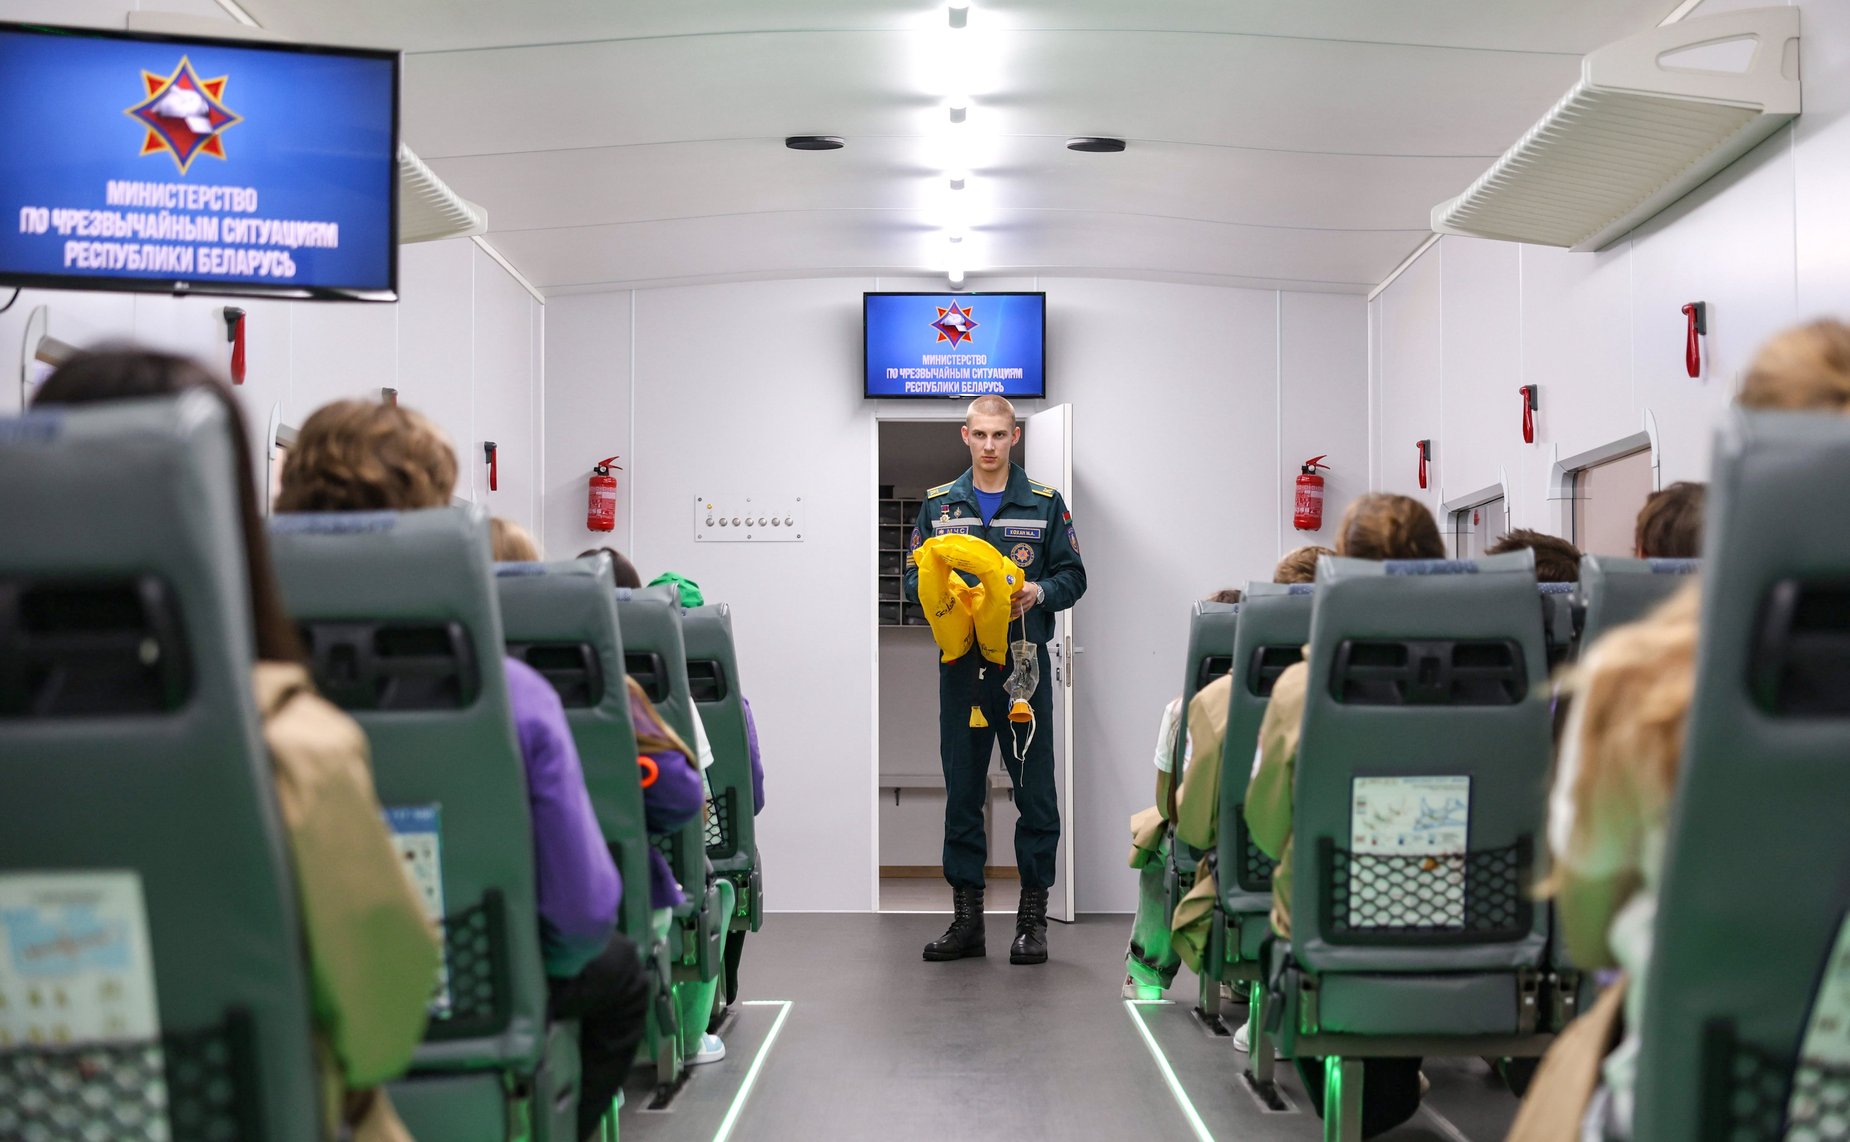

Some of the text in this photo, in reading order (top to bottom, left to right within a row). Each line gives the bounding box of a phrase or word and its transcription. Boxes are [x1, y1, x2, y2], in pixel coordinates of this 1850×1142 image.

[106, 180, 257, 212] МИНИСТЕРСТВО
[19, 207, 339, 248] ПО ЧРЕЗВЫЧАЙНЫМ СИТУАЦИЯМ
[64, 241, 296, 278] РЕСПУБЛИКИ БЕЛАРУСЬ
[922, 354, 987, 366] МИНИСТЕРСТВО
[886, 366, 1023, 380] ПО ЧРЕЗВЫЧАЙНЫМ СИТУАЦИЯМ
[905, 381, 1004, 393] РЕСПУБЛИКИ БЕЛАРУСЬ
